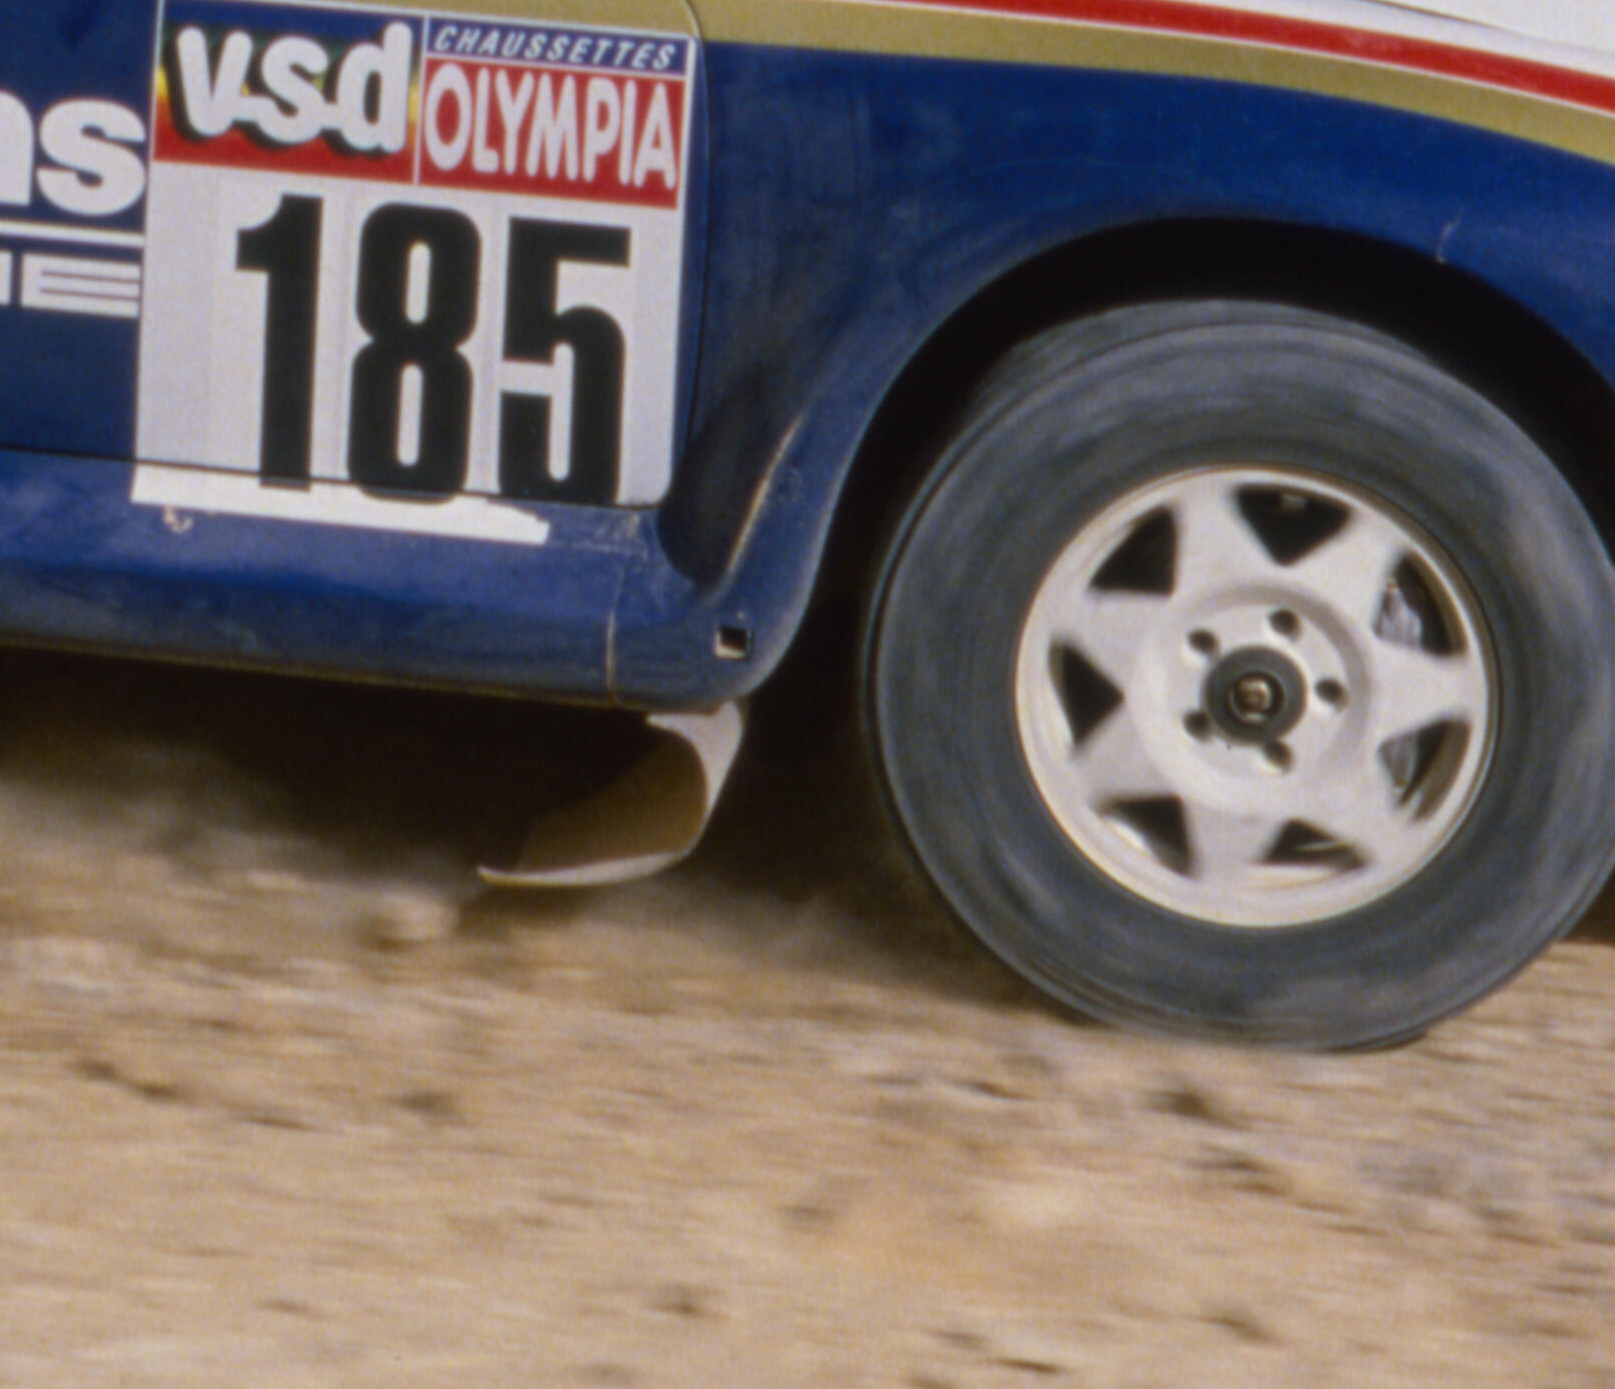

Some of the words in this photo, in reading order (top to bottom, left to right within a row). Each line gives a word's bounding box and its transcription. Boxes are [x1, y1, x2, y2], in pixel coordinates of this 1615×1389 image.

[176, 21, 413, 153] vsd
[433, 24, 678, 71] CHAUSSETTES
[422, 62, 678, 190] OLYMPIA
[234, 192, 632, 505] 185
